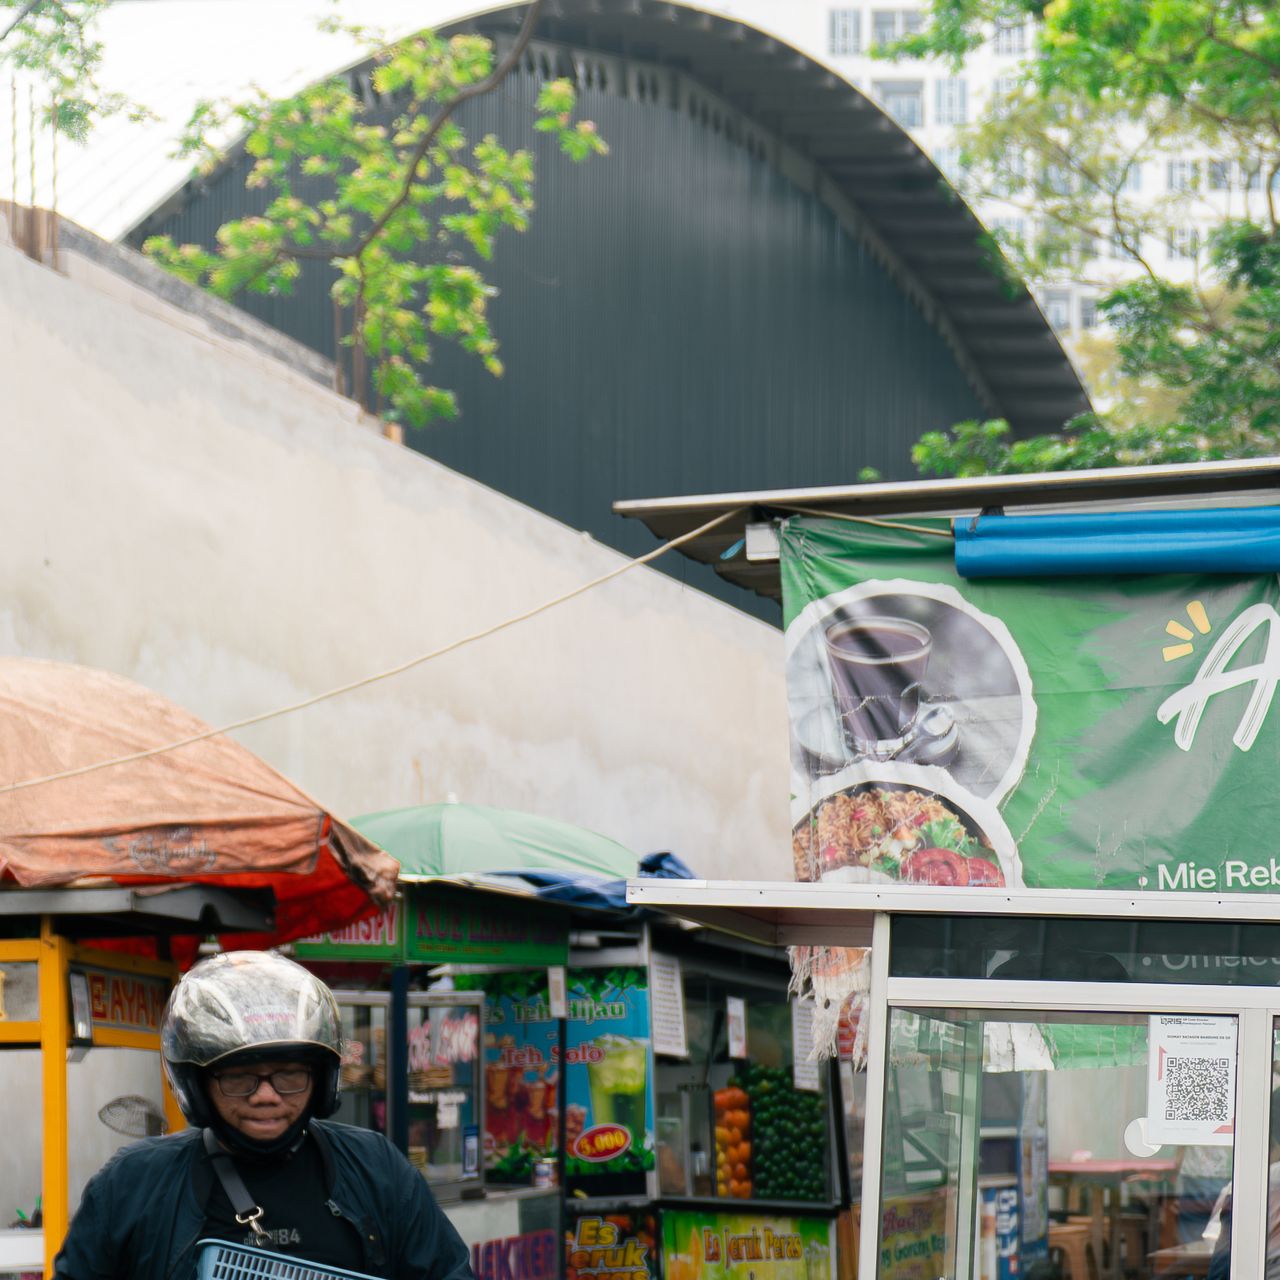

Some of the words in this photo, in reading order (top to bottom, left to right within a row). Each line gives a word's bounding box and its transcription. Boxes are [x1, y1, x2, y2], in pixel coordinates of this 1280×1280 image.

[1157, 861, 1216, 891] Mie
[513, 1003, 549, 1022] Teh
[567, 999, 625, 1024] Hijau
[504, 1048, 543, 1066] Teh
[579, 1219, 615, 1246] Es
[703, 1229, 721, 1263] Es
[724, 1229, 763, 1270] Jeruk
[764, 1228, 801, 1262] Peras
